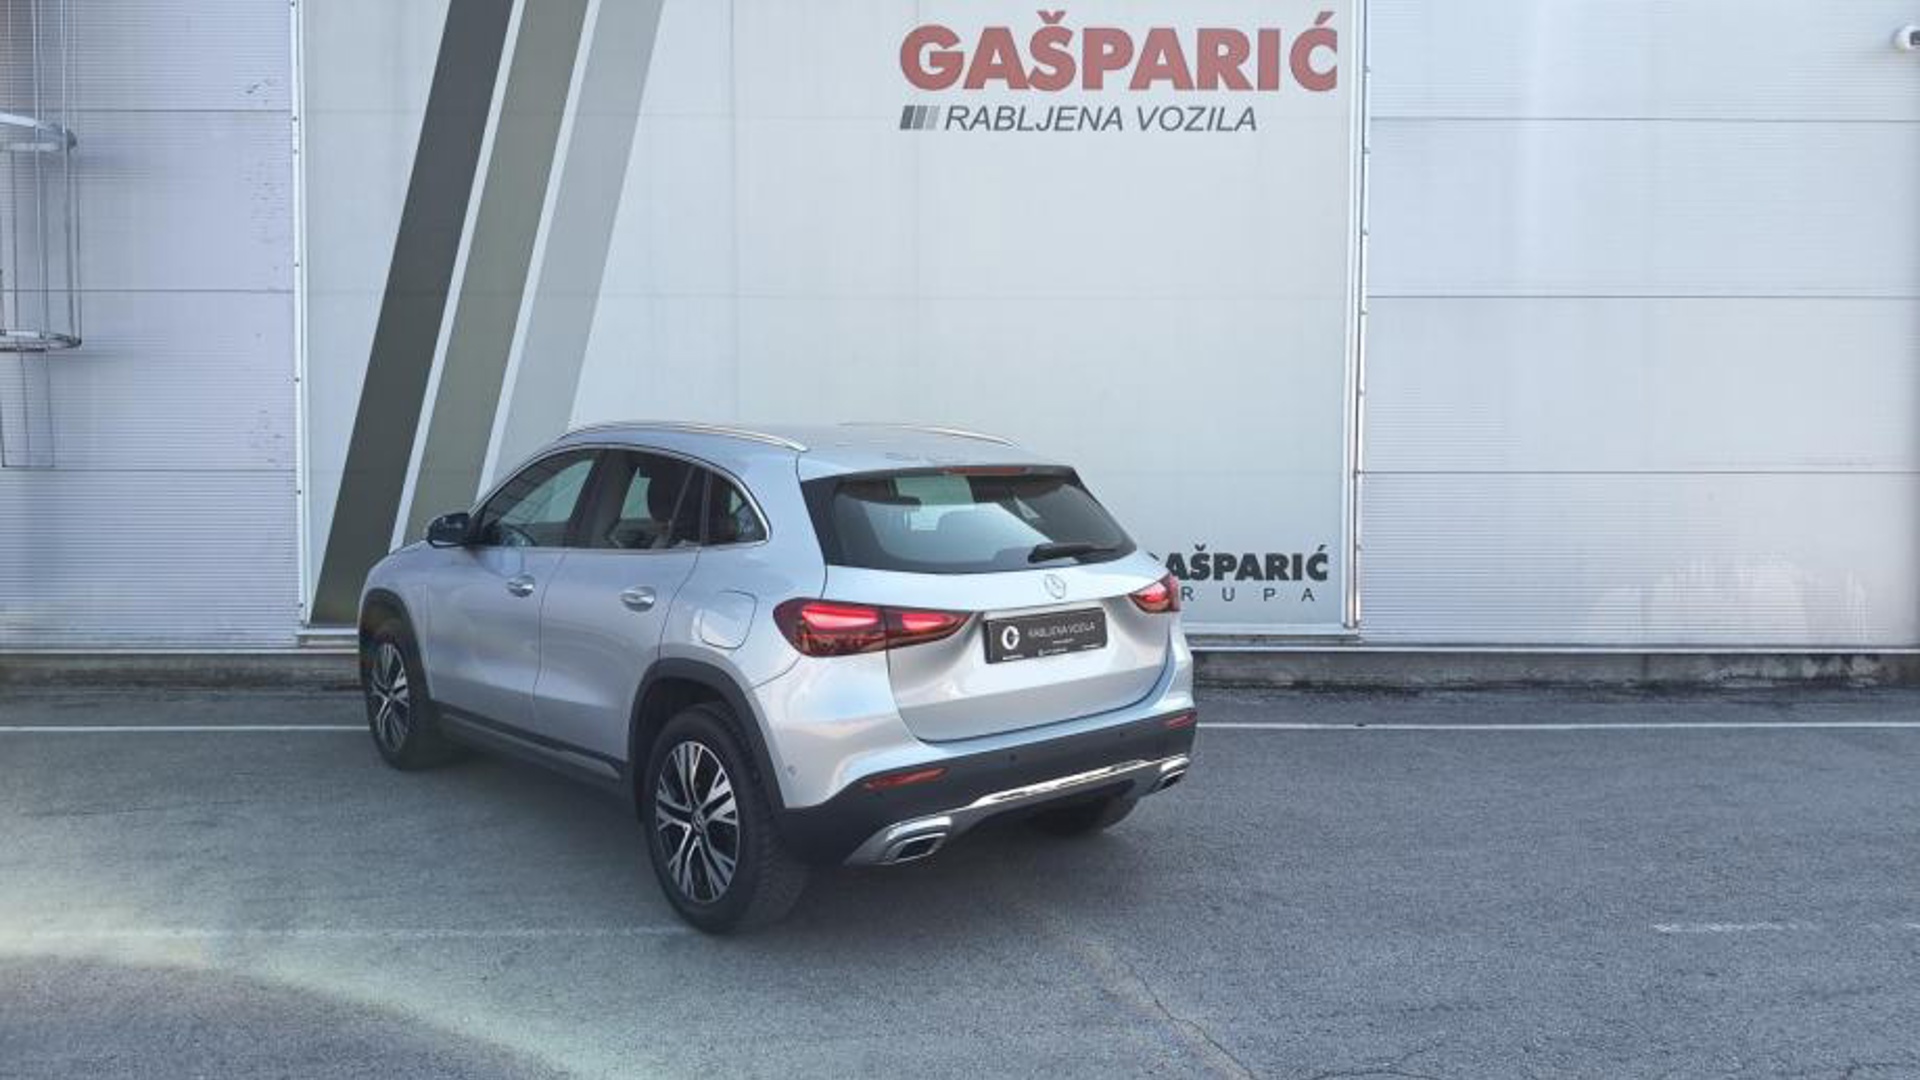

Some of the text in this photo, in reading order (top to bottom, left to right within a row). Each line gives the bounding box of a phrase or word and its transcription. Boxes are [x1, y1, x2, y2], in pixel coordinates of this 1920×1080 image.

[900, 11, 1337, 91] GAŠPARIĆ
[945, 105, 1257, 132] RABLJENA VOZILA
[1149, 544, 1328, 581] AŠPARIĆ
[1181, 586, 1315, 602] RUPA
